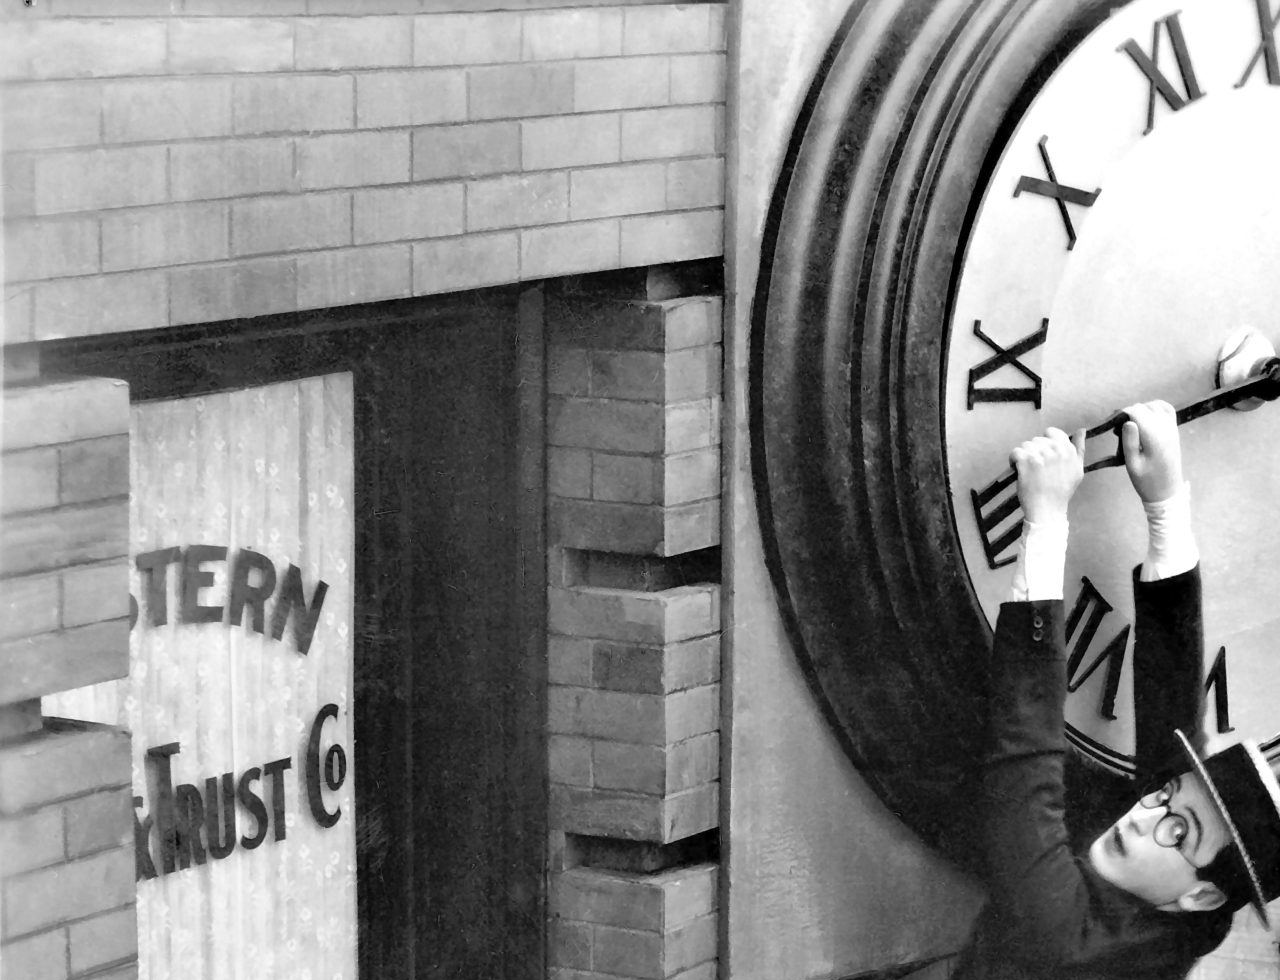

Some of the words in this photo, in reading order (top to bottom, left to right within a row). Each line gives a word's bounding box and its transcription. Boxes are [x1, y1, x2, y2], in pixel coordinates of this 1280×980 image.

[1115, 9, 1207, 136] XI
[1013, 135, 1102, 251] X
[967, 317, 1050, 411] IX
[129, 543, 330, 657] TERN
[145, 741, 292, 876] TRUST
